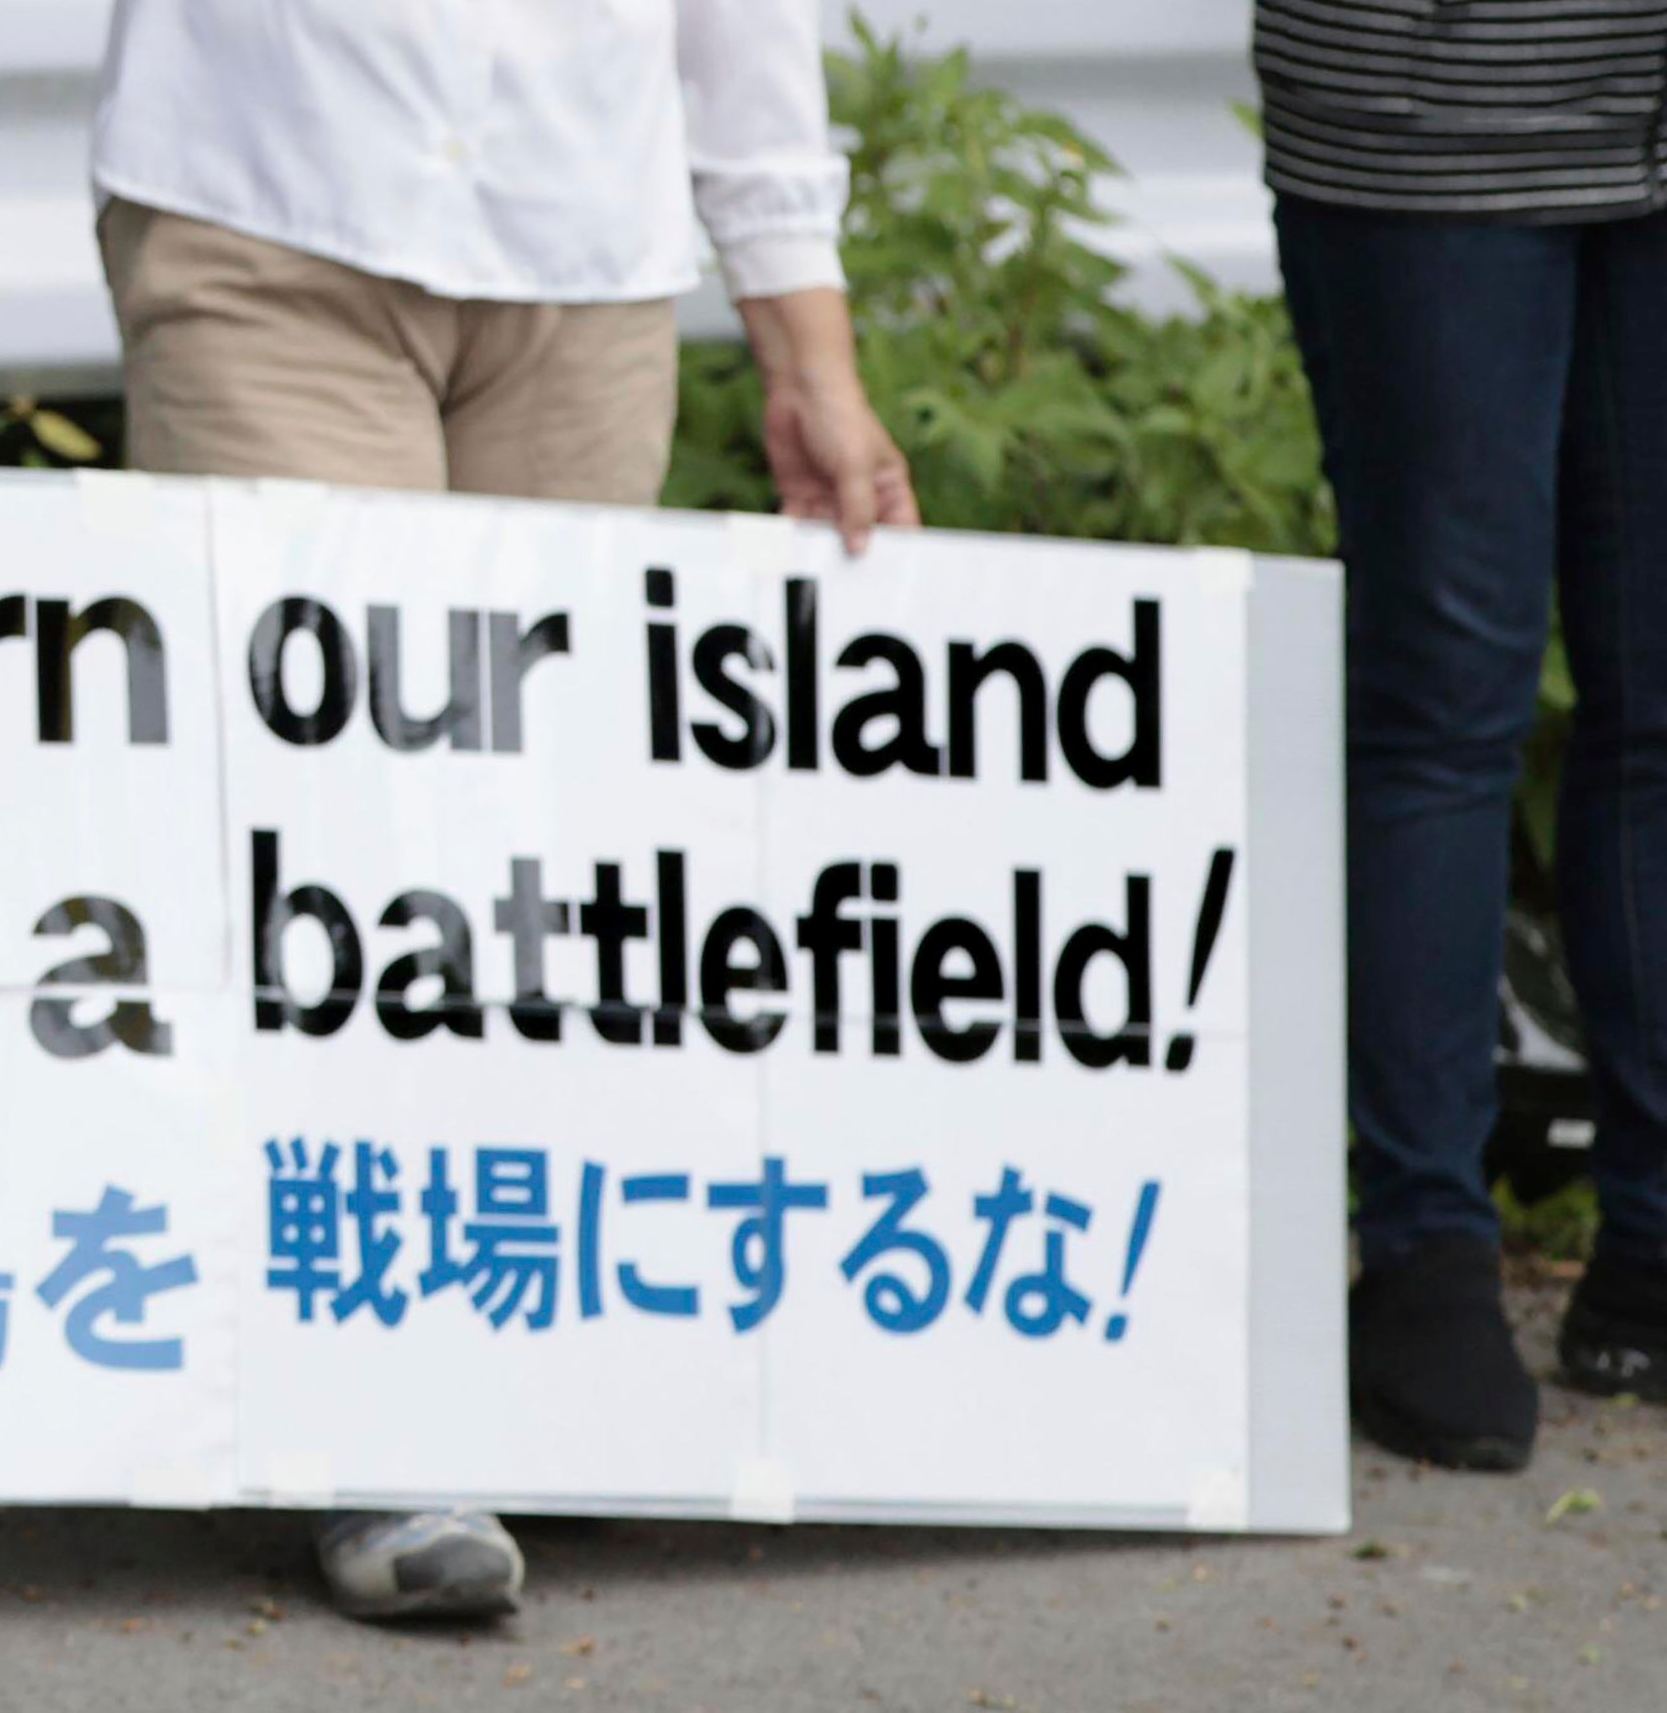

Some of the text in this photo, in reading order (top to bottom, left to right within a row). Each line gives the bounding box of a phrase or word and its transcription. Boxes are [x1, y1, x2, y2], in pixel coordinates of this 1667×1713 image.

[247, 594, 571, 752] our
[644, 568, 1162, 789] island
[29, 895, 174, 1058] a
[250, 828, 1236, 1073] battlefield!
